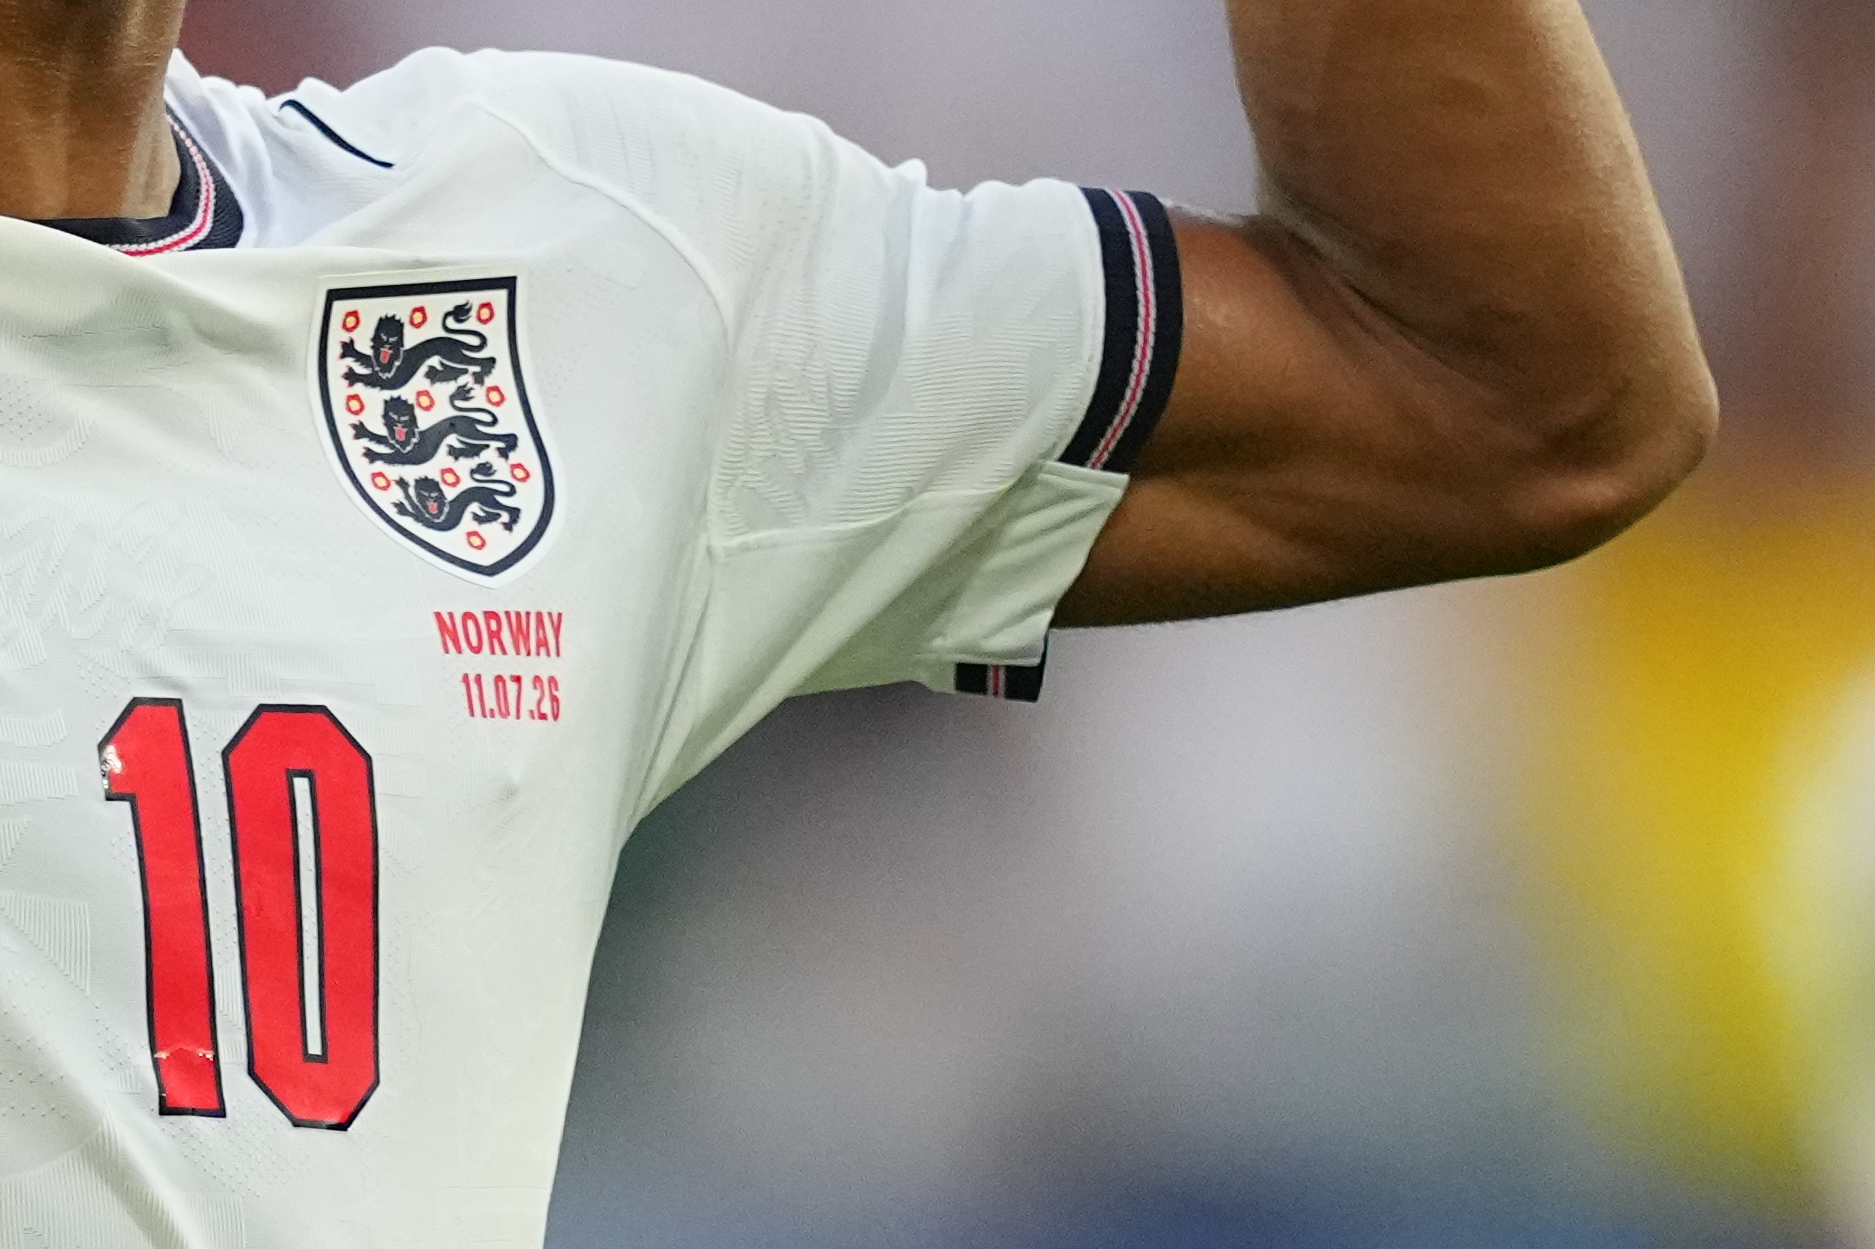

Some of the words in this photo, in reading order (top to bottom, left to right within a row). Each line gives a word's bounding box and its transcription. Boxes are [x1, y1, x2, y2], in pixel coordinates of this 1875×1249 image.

[433, 611, 563, 657] NORWAY
[462, 672, 561, 722] 11.07.26
[98, 696, 380, 1132] 10
